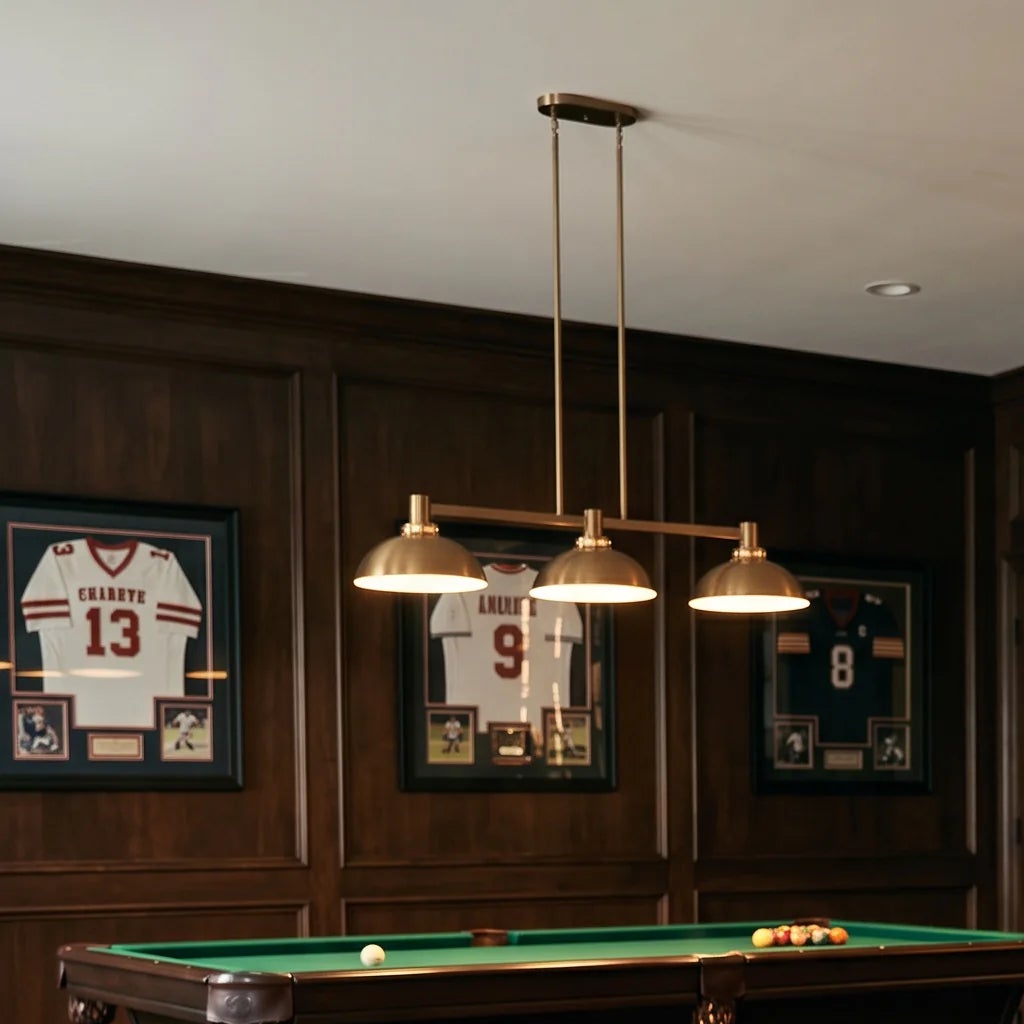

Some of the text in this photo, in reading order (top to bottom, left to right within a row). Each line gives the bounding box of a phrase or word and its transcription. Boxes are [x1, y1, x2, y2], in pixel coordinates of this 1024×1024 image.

[86, 606, 141, 657] 13
[493, 624, 523, 679] 9
[830, 644, 854, 689] 8
